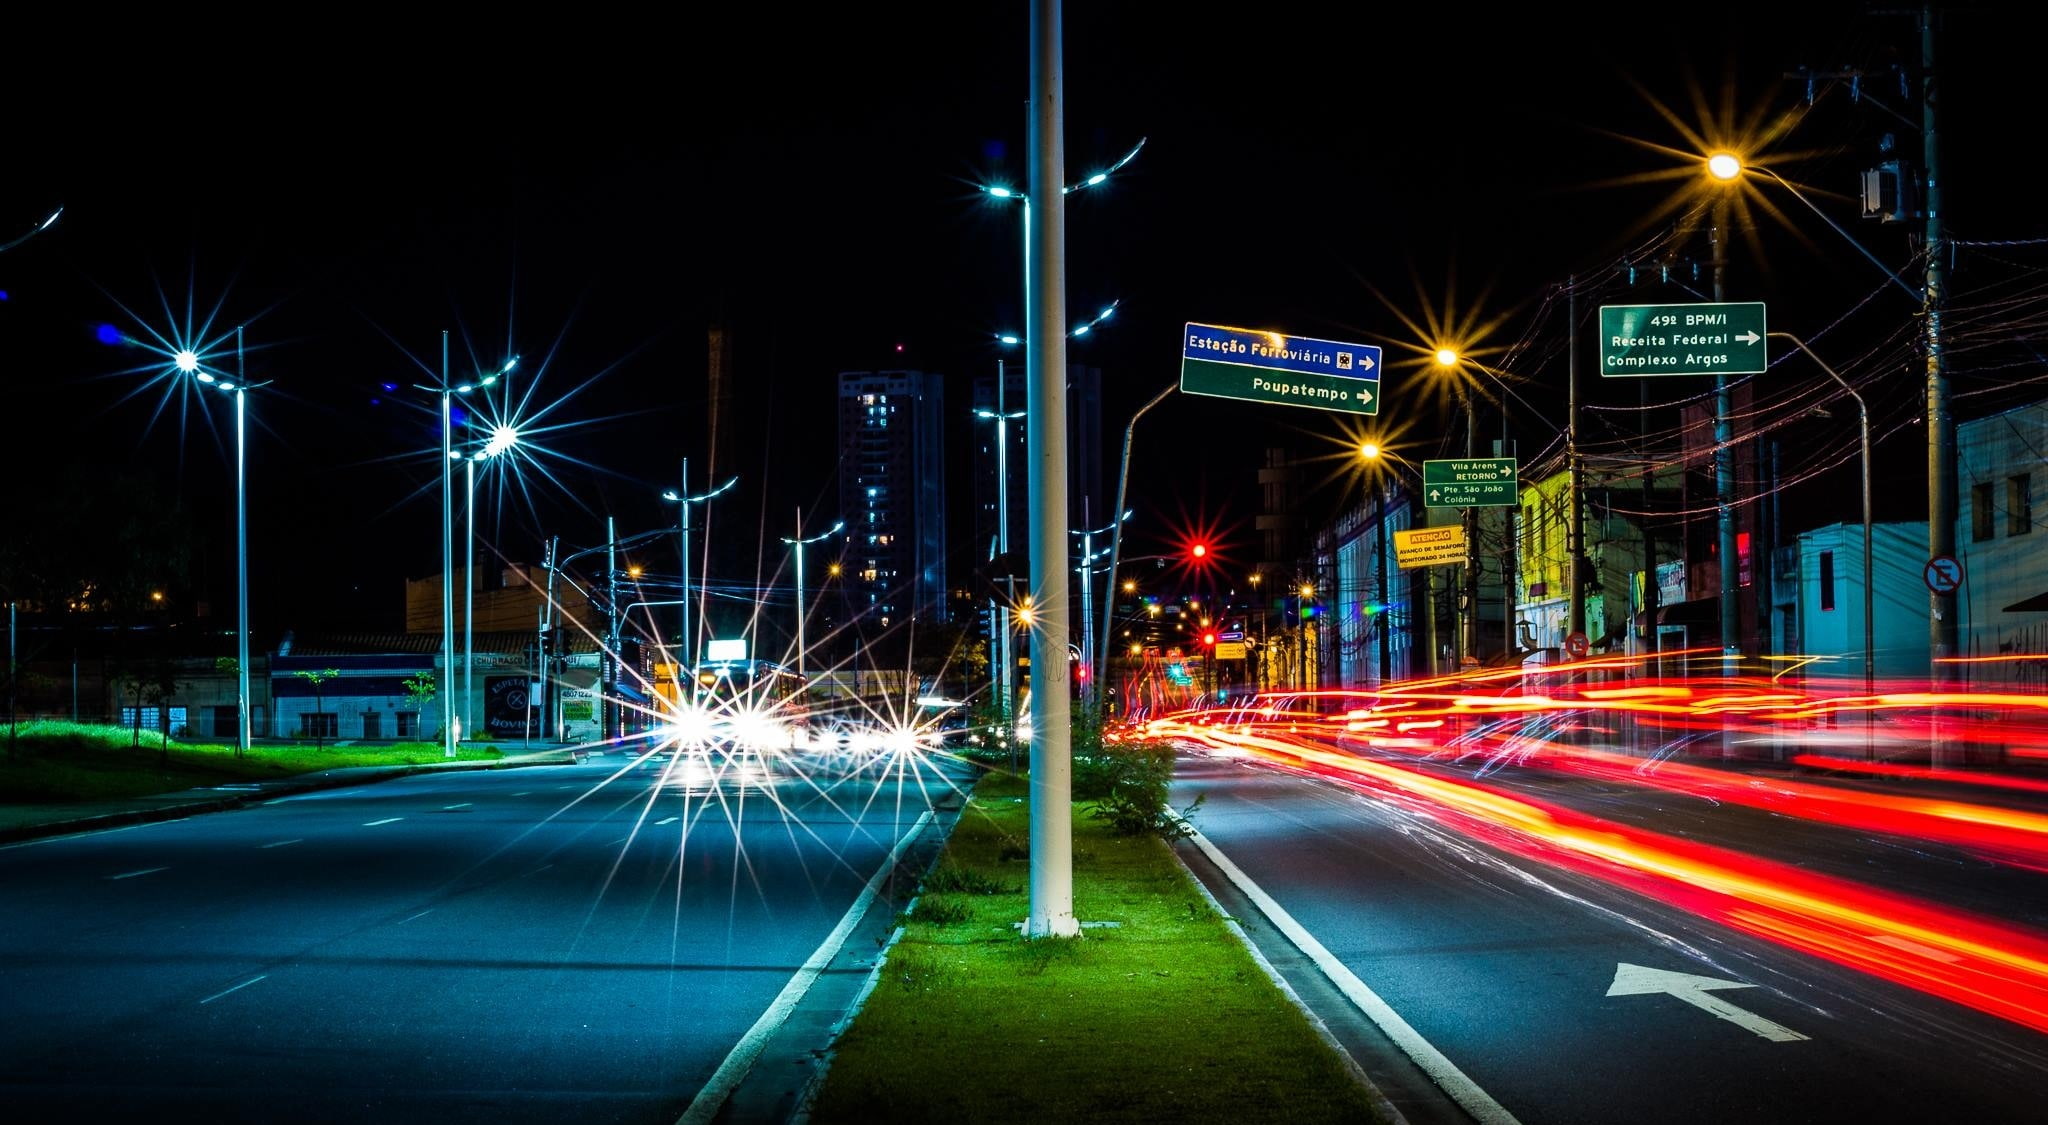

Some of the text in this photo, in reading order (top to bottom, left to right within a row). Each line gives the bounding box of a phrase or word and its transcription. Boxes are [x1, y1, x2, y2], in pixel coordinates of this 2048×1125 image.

[1612, 333, 1728, 347] Receita Federal
[1189, 335, 1331, 365] Estação Ferroviária
[1607, 353, 1728, 368] Complexo Argos
[1253, 377, 1348, 402] Poupatempo
[1451, 462, 1497, 471] Vila Arens
[1456, 472, 1498, 481] RETORNO
[1464, 485, 1480, 493] São
[1483, 485, 1504, 493] João
[1444, 495, 1476, 504] Colônia
[1411, 530, 1451, 543] ATENÇÃO
[1400, 546, 1423, 555] AVANÇO
[1433, 542, 1466, 551] SEMÁFORO
[1400, 554, 1437, 564] MONITORADO
[490, 716, 538, 729] BOVINO
